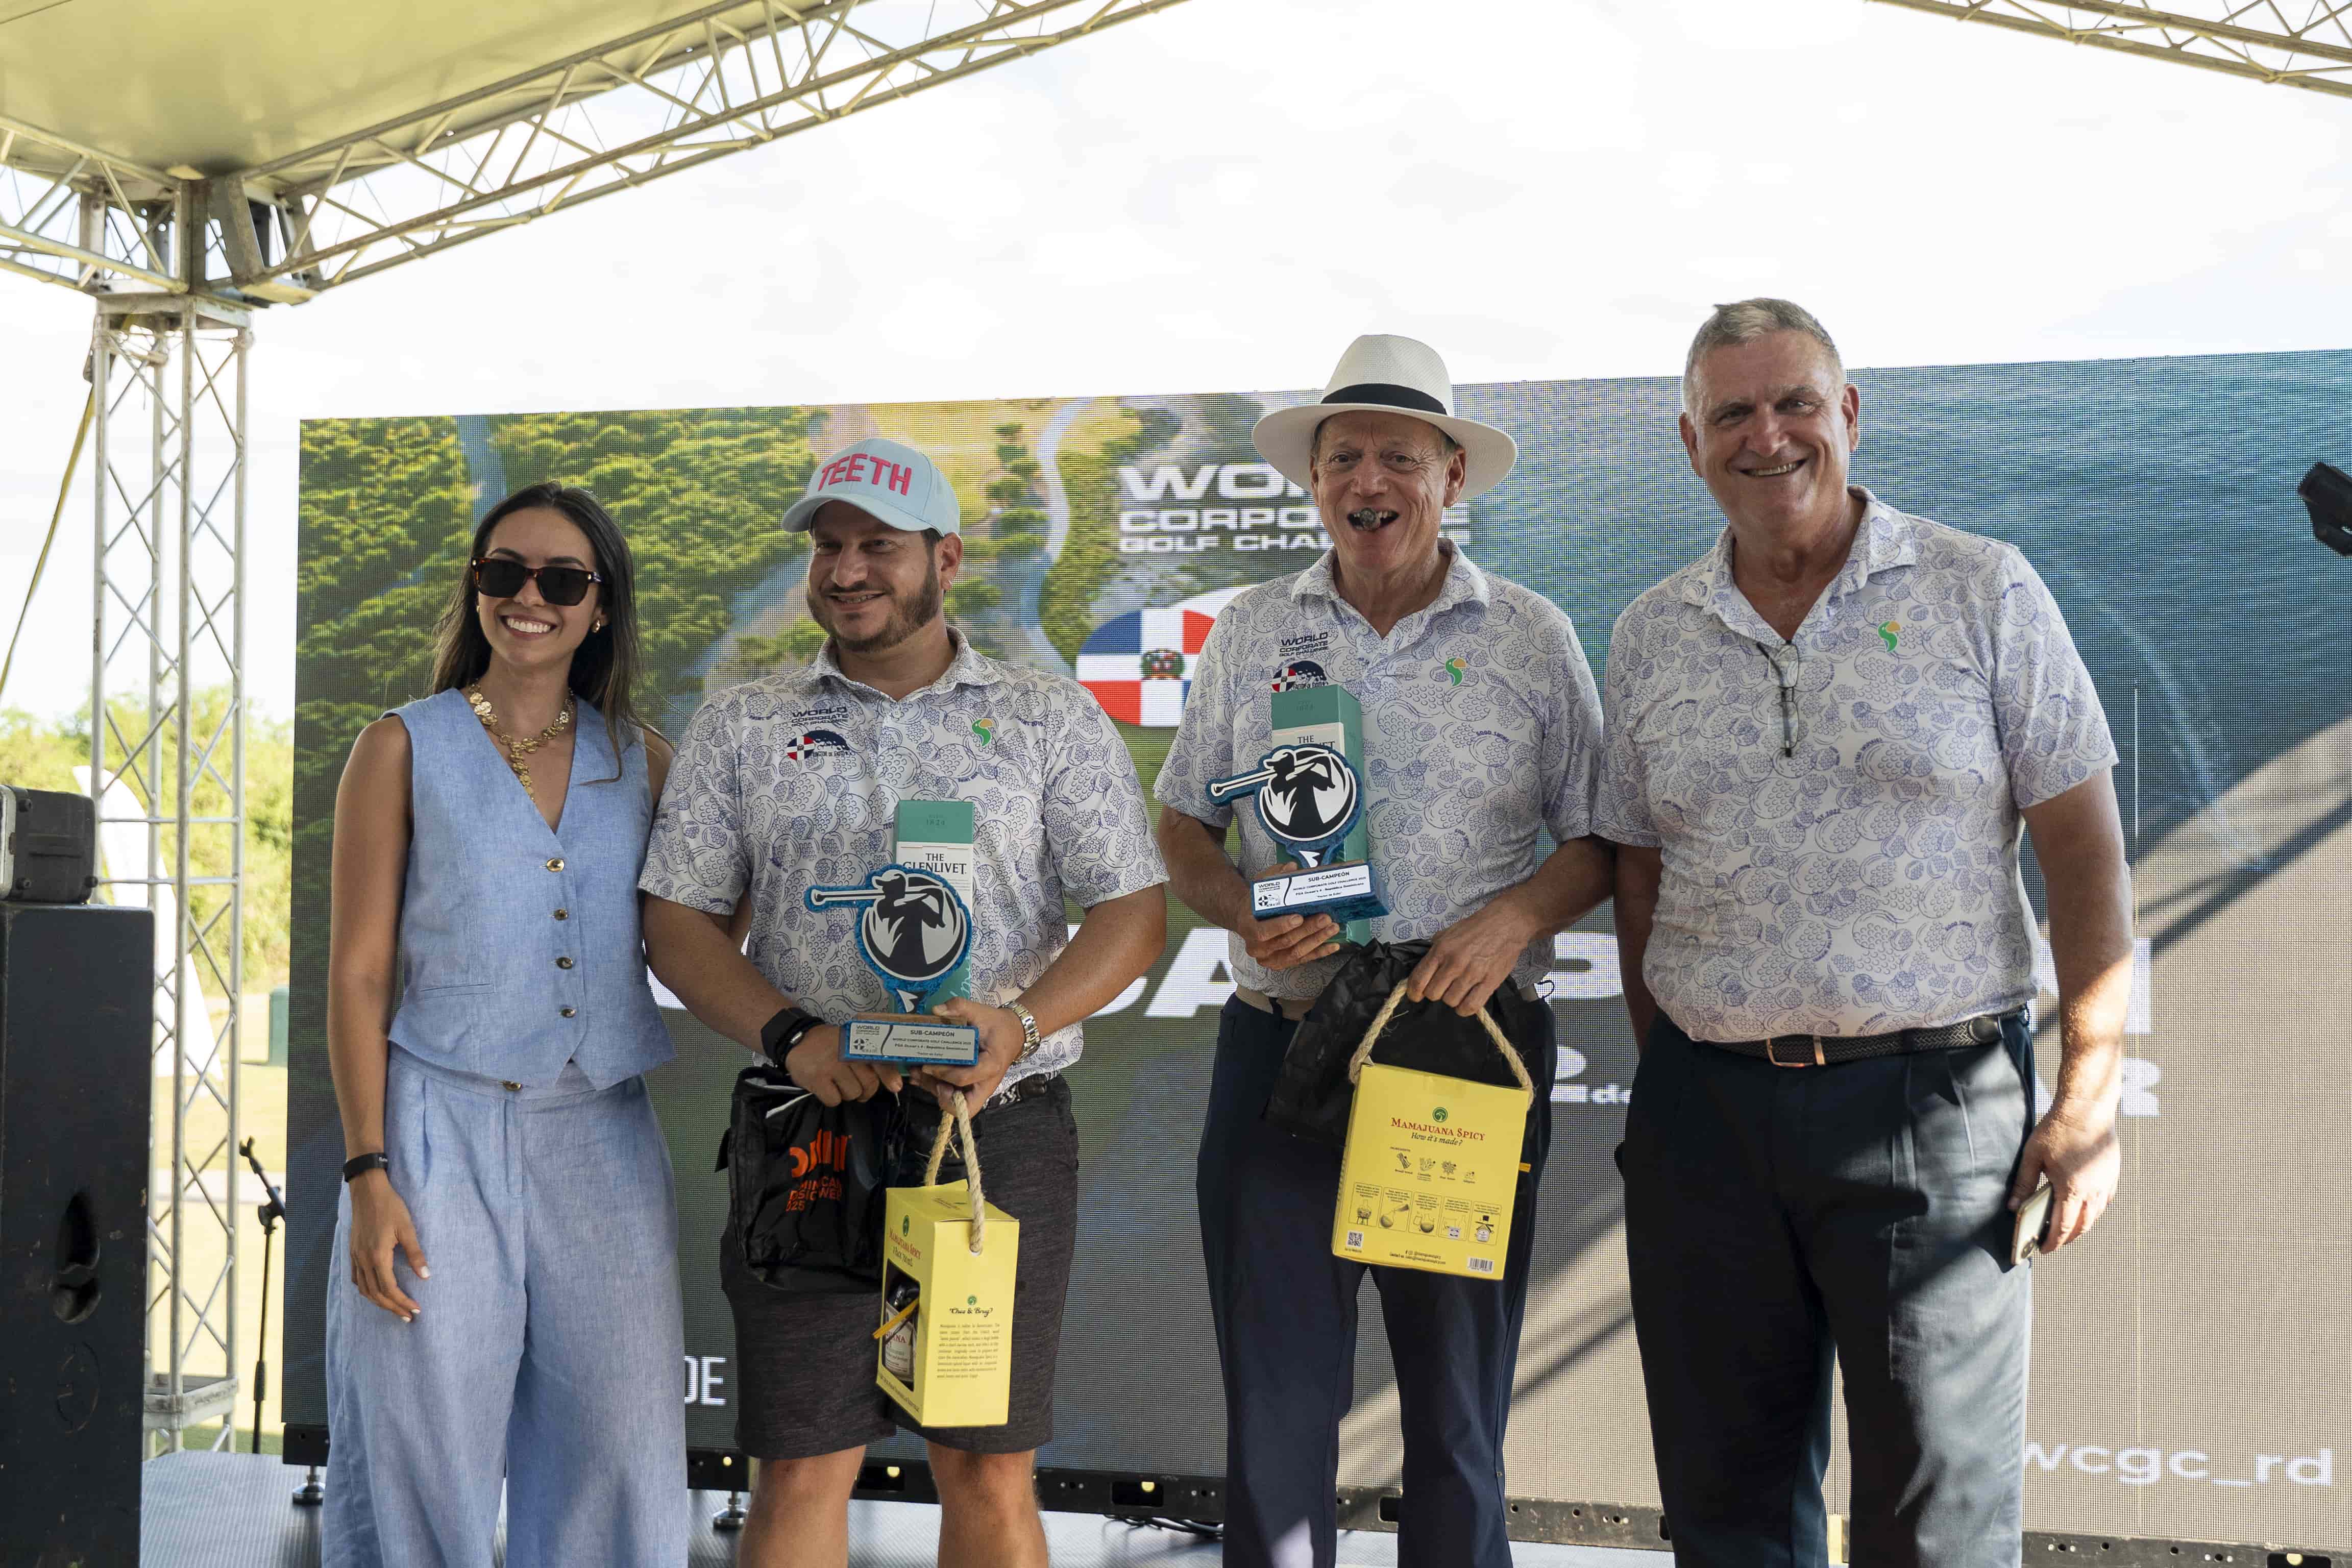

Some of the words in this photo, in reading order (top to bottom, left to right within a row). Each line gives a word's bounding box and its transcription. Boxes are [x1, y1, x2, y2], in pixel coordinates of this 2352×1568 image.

[818, 453, 912, 496] TEETH
[1118, 537, 1219, 553] GOLF
[1281, 632, 1328, 646] WORLD
[1280, 641, 1328, 652] CORPORATE
[792, 706, 848, 717] WORLD
[792, 714, 849, 723] CORPORATE
[1297, 735, 1314, 744] THE
[925, 853, 944, 862] THE
[1308, 871, 1350, 883] SUB-CAMPEÓN
[910, 1029, 954, 1037] SUB-CAMPEÓN
[1391, 1117, 1454, 1136] MAMAJUANA
[1457, 1128, 1485, 1141] SPICY
[1411, 1132, 1426, 1140] How
[1439, 1137, 1463, 1146] made?
